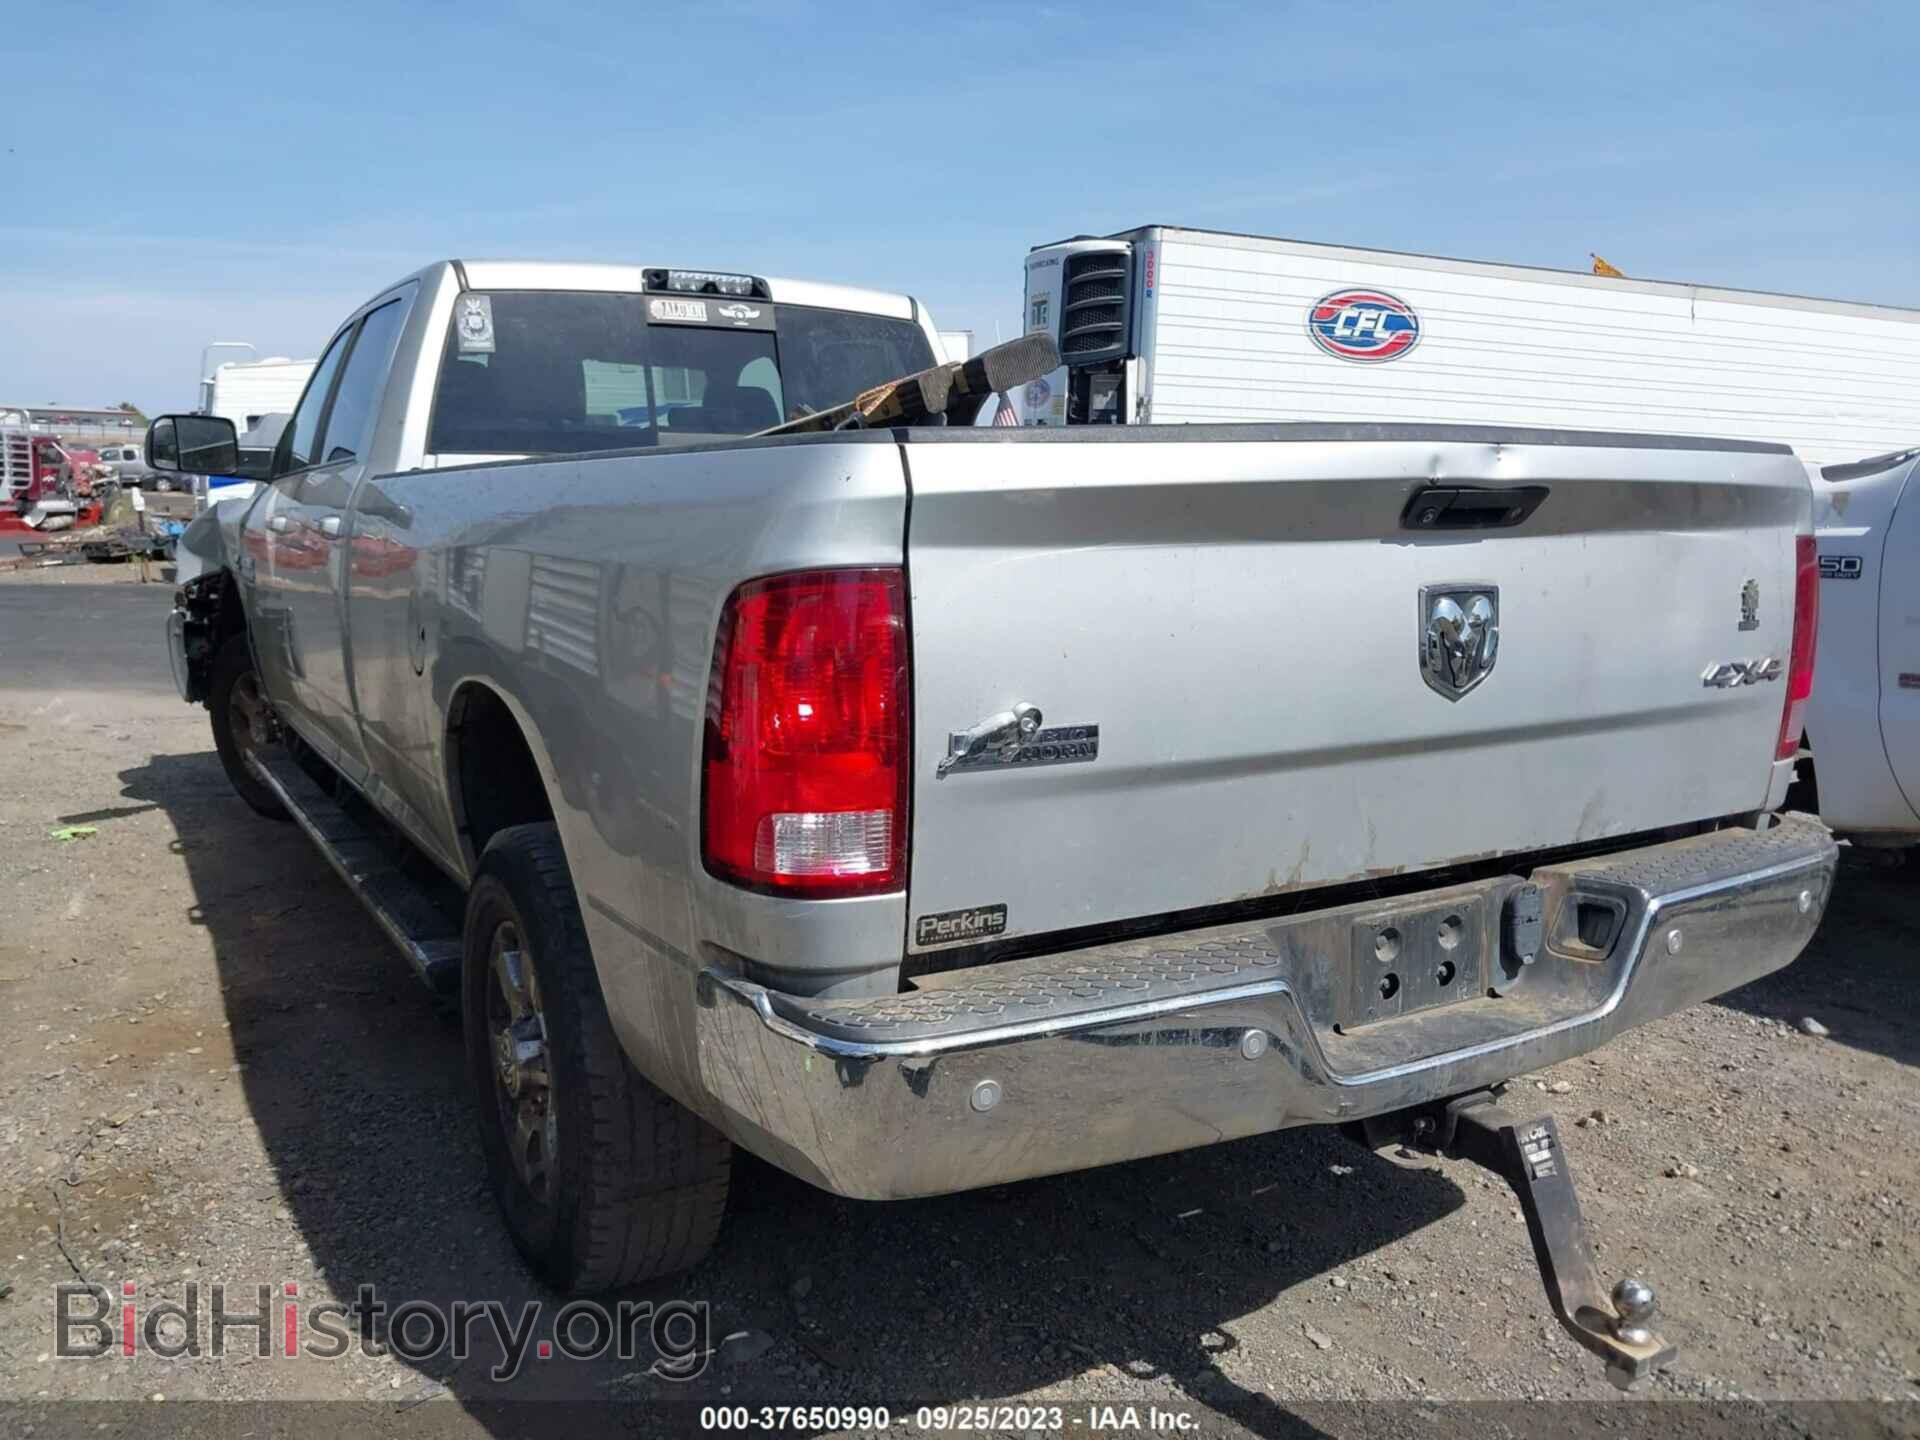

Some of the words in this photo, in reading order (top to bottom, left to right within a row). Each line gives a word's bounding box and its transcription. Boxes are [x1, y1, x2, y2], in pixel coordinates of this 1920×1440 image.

[1333, 308, 1392, 339] CFL
[1819, 556, 1861, 572] 50
[1037, 728, 1088, 744] BIG
[1020, 742, 1097, 763] HORN
[919, 911, 1005, 937] Perkins
